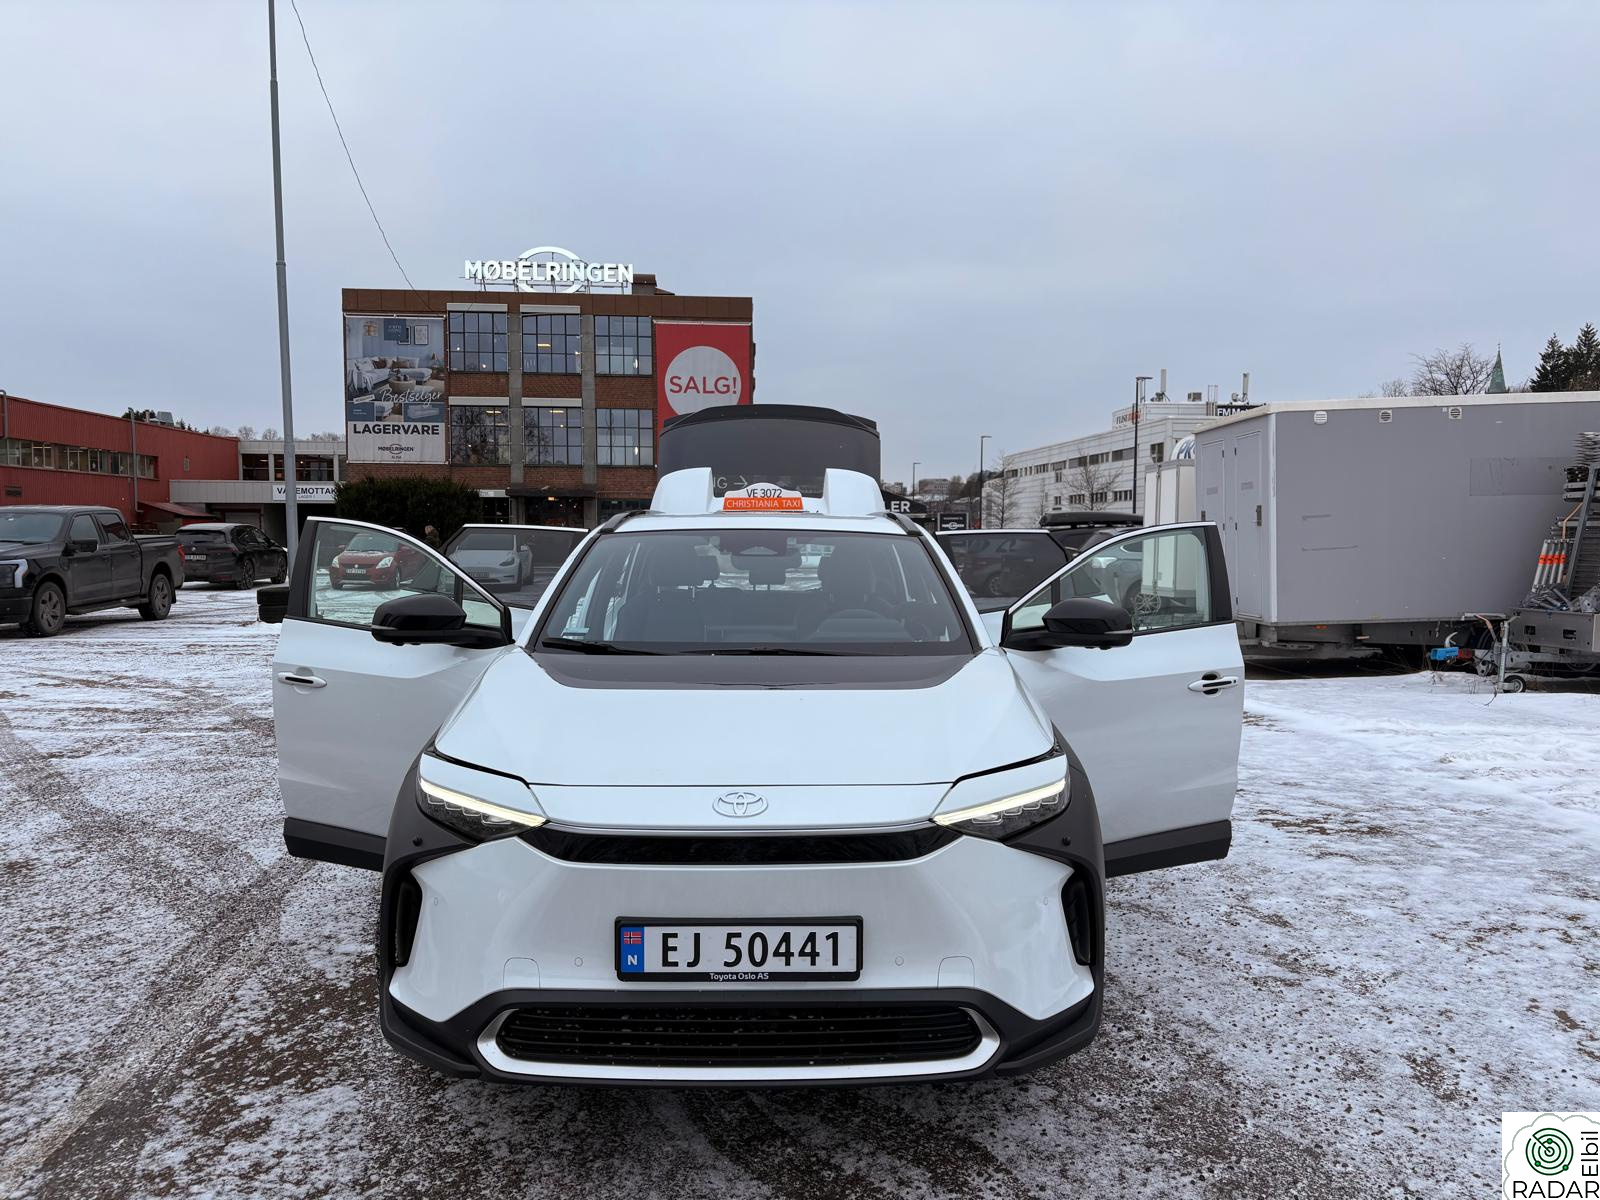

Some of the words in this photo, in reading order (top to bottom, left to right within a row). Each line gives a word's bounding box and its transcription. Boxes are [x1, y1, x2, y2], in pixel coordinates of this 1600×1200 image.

[464, 260, 634, 283] MØBELRINGEN
[669, 375, 738, 395] SALG!
[380, 387, 441, 407] Bestselger
[353, 423, 441, 436] LAGERVARE
[746, 489, 759, 498] VE
[760, 489, 783, 498] 3072
[726, 500, 780, 508] CHRISTIANIA
[782, 499, 801, 508] TAXI
[661, 932, 701, 968] EJ
[723, 931, 839, 968] 50441
[627, 955, 638, 966] N
[709, 973, 737, 981] Toyota
[738, 972, 756, 980] Oslo
[757, 972, 769, 980] AS
